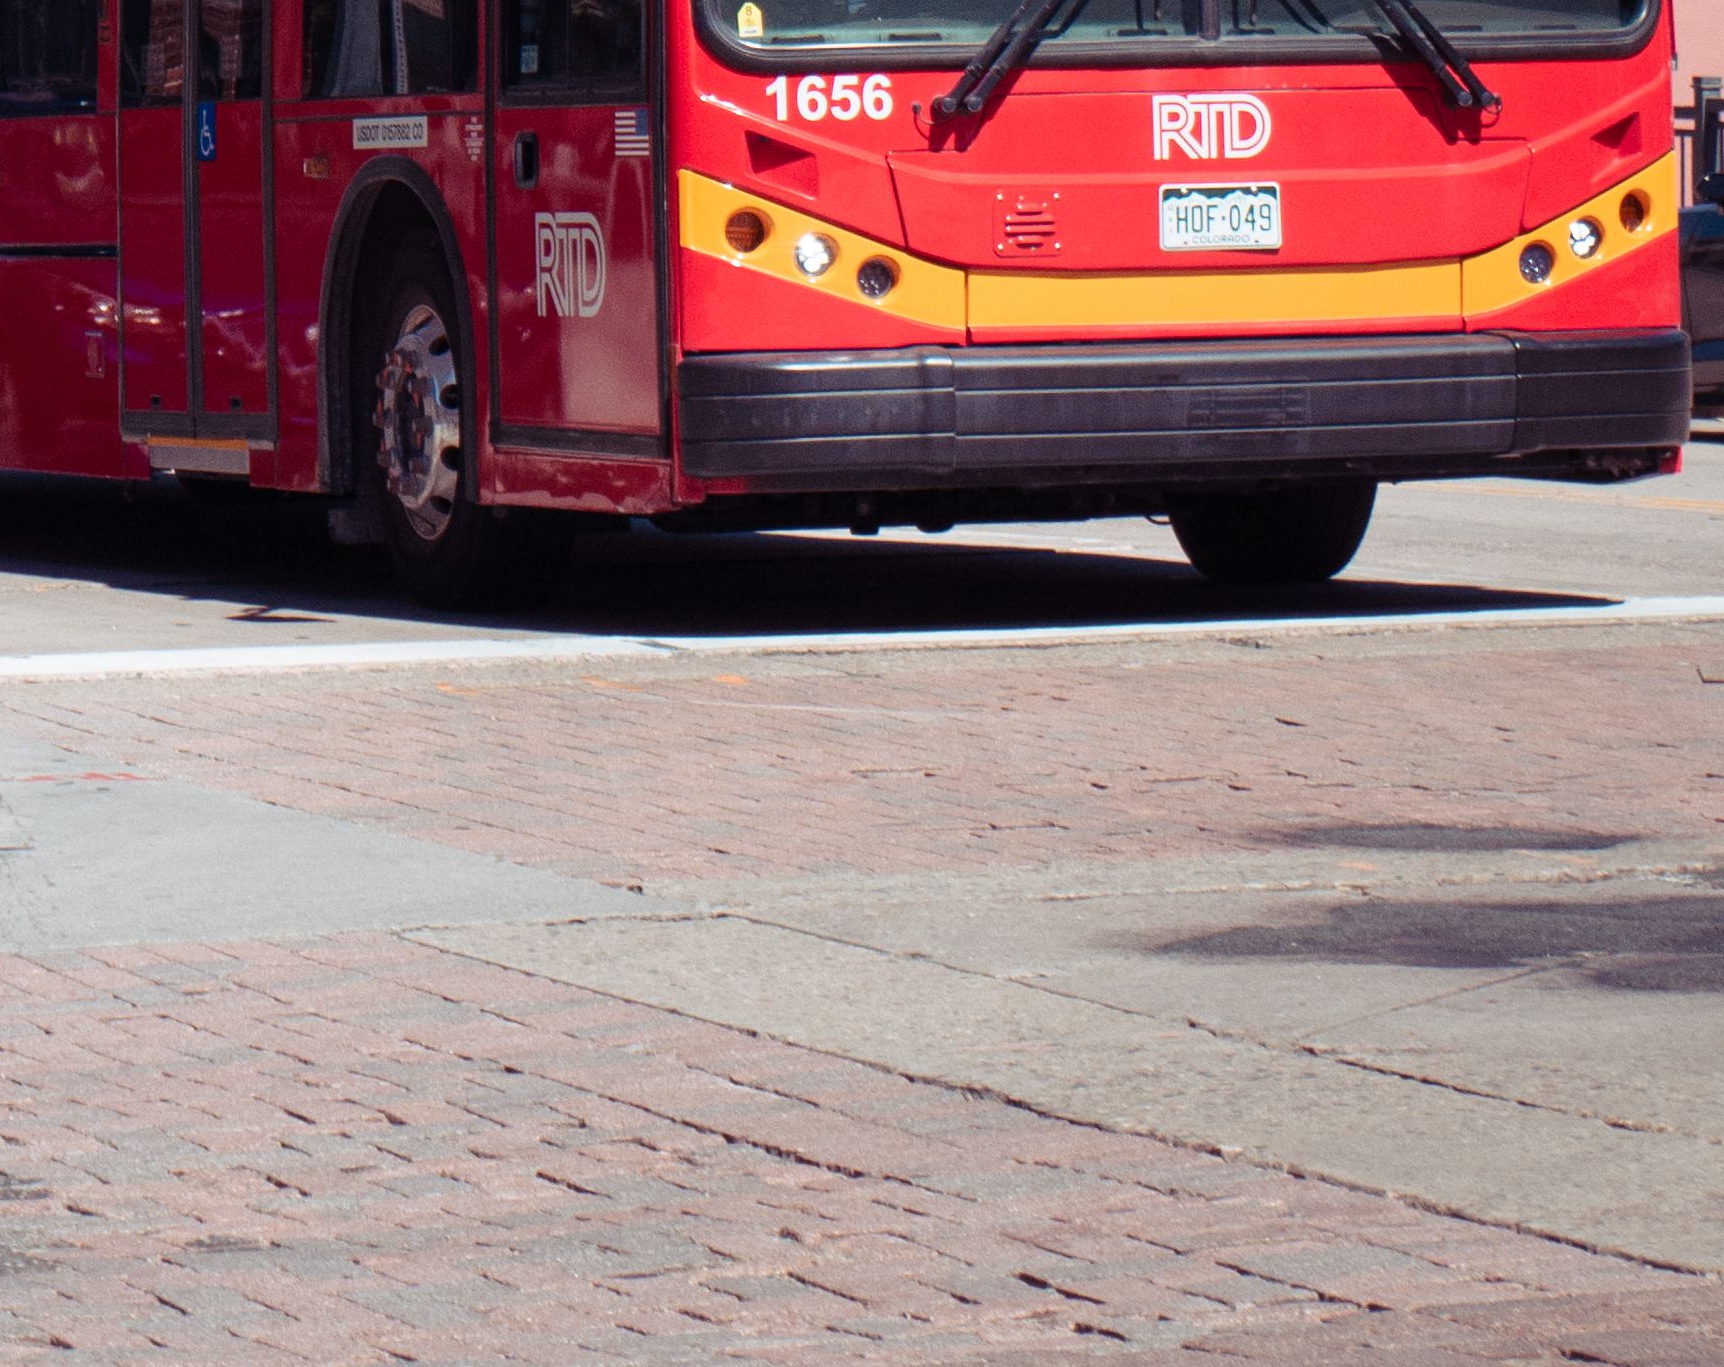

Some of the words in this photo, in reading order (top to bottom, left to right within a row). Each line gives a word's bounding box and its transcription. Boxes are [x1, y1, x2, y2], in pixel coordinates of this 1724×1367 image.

[765, 74, 893, 122] 1656
[1153, 93, 1272, 162] RTD
[535, 211, 606, 318] RTD
[1192, 233, 1251, 244] COLORADO
